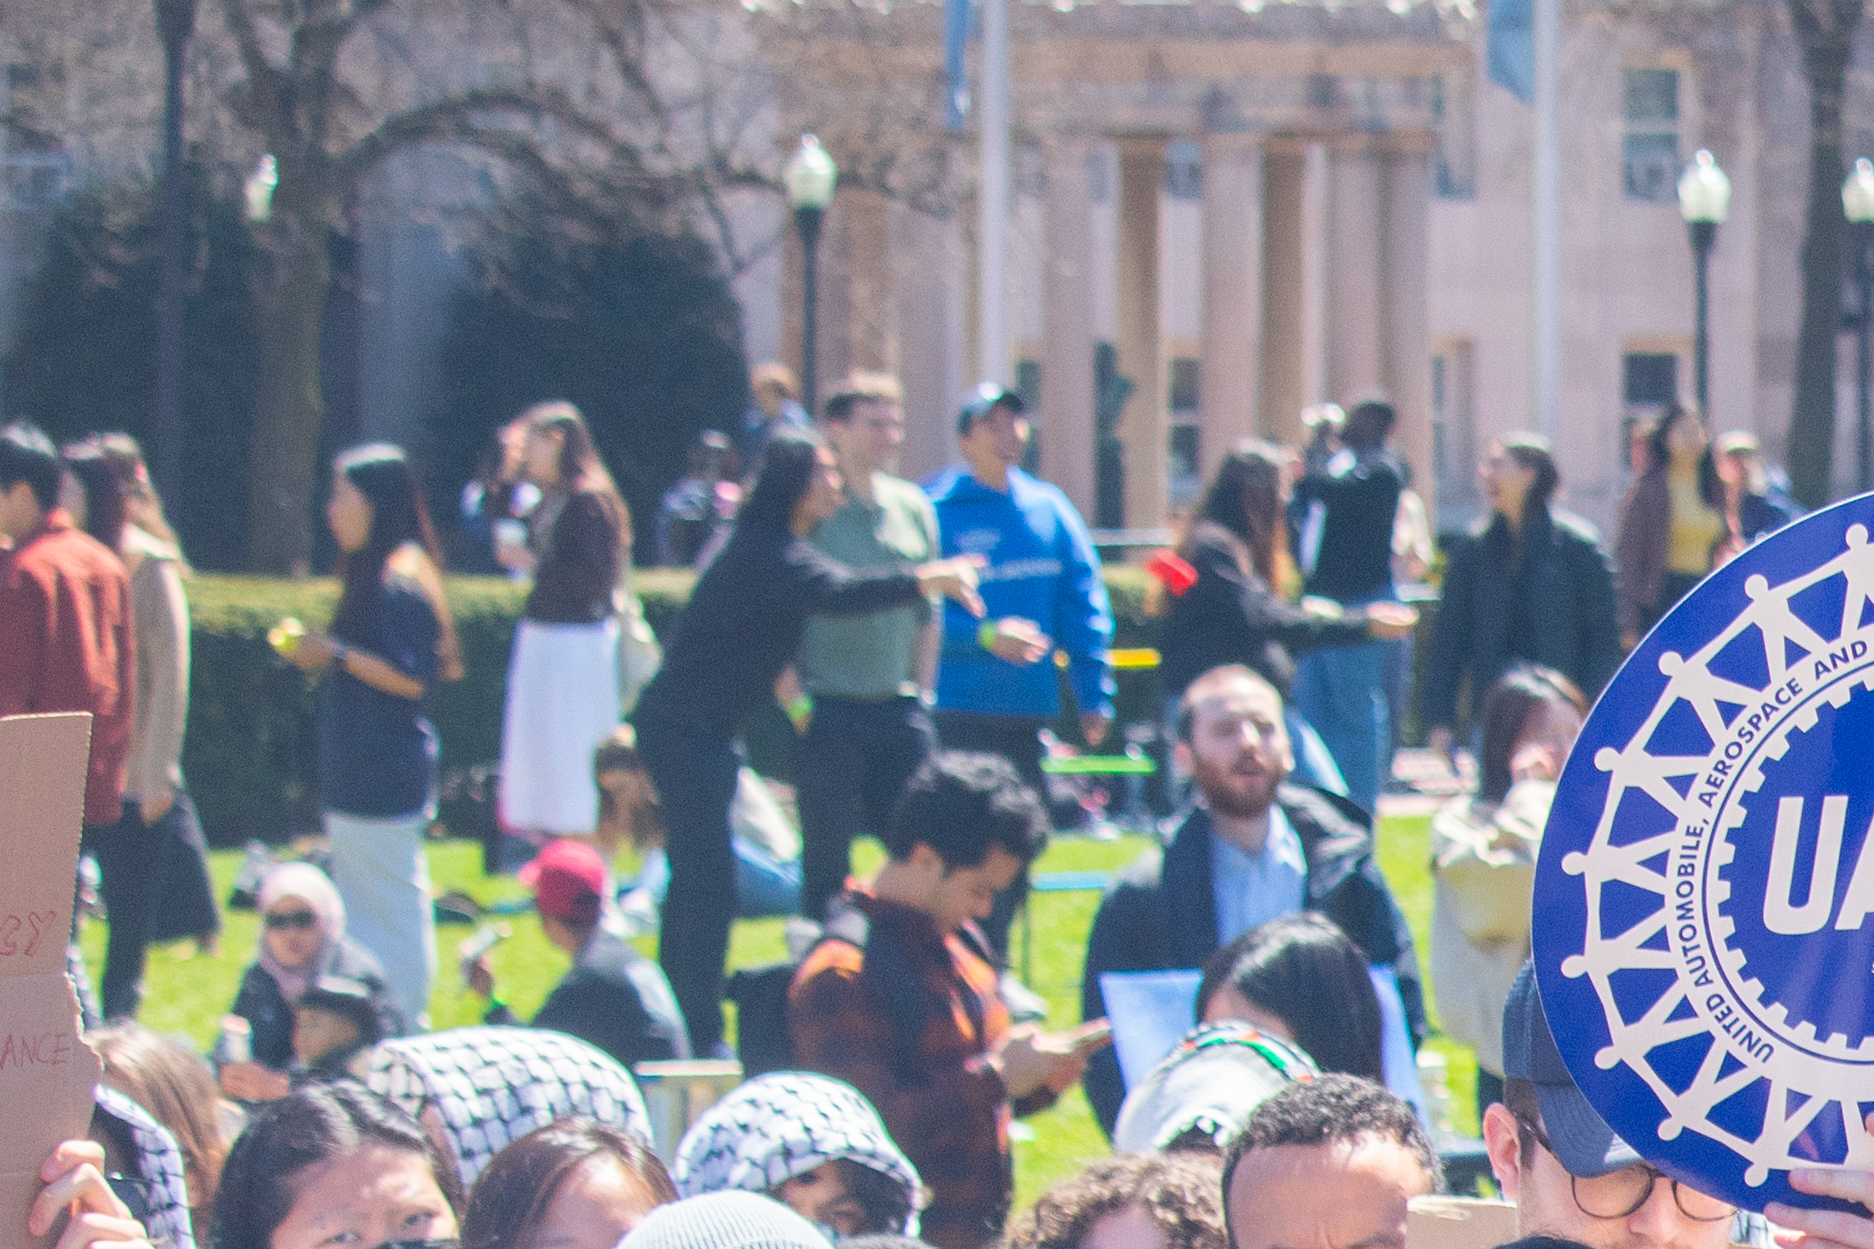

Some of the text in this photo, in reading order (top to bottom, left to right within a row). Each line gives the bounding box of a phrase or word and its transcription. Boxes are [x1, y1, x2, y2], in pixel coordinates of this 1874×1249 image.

[1812, 639, 1869, 681] AND
[1697, 677, 1804, 810] AEROSPACE
[1674, 818, 1715, 988] AUTOMOBILE,
[1705, 992, 1775, 1064] UNITED
